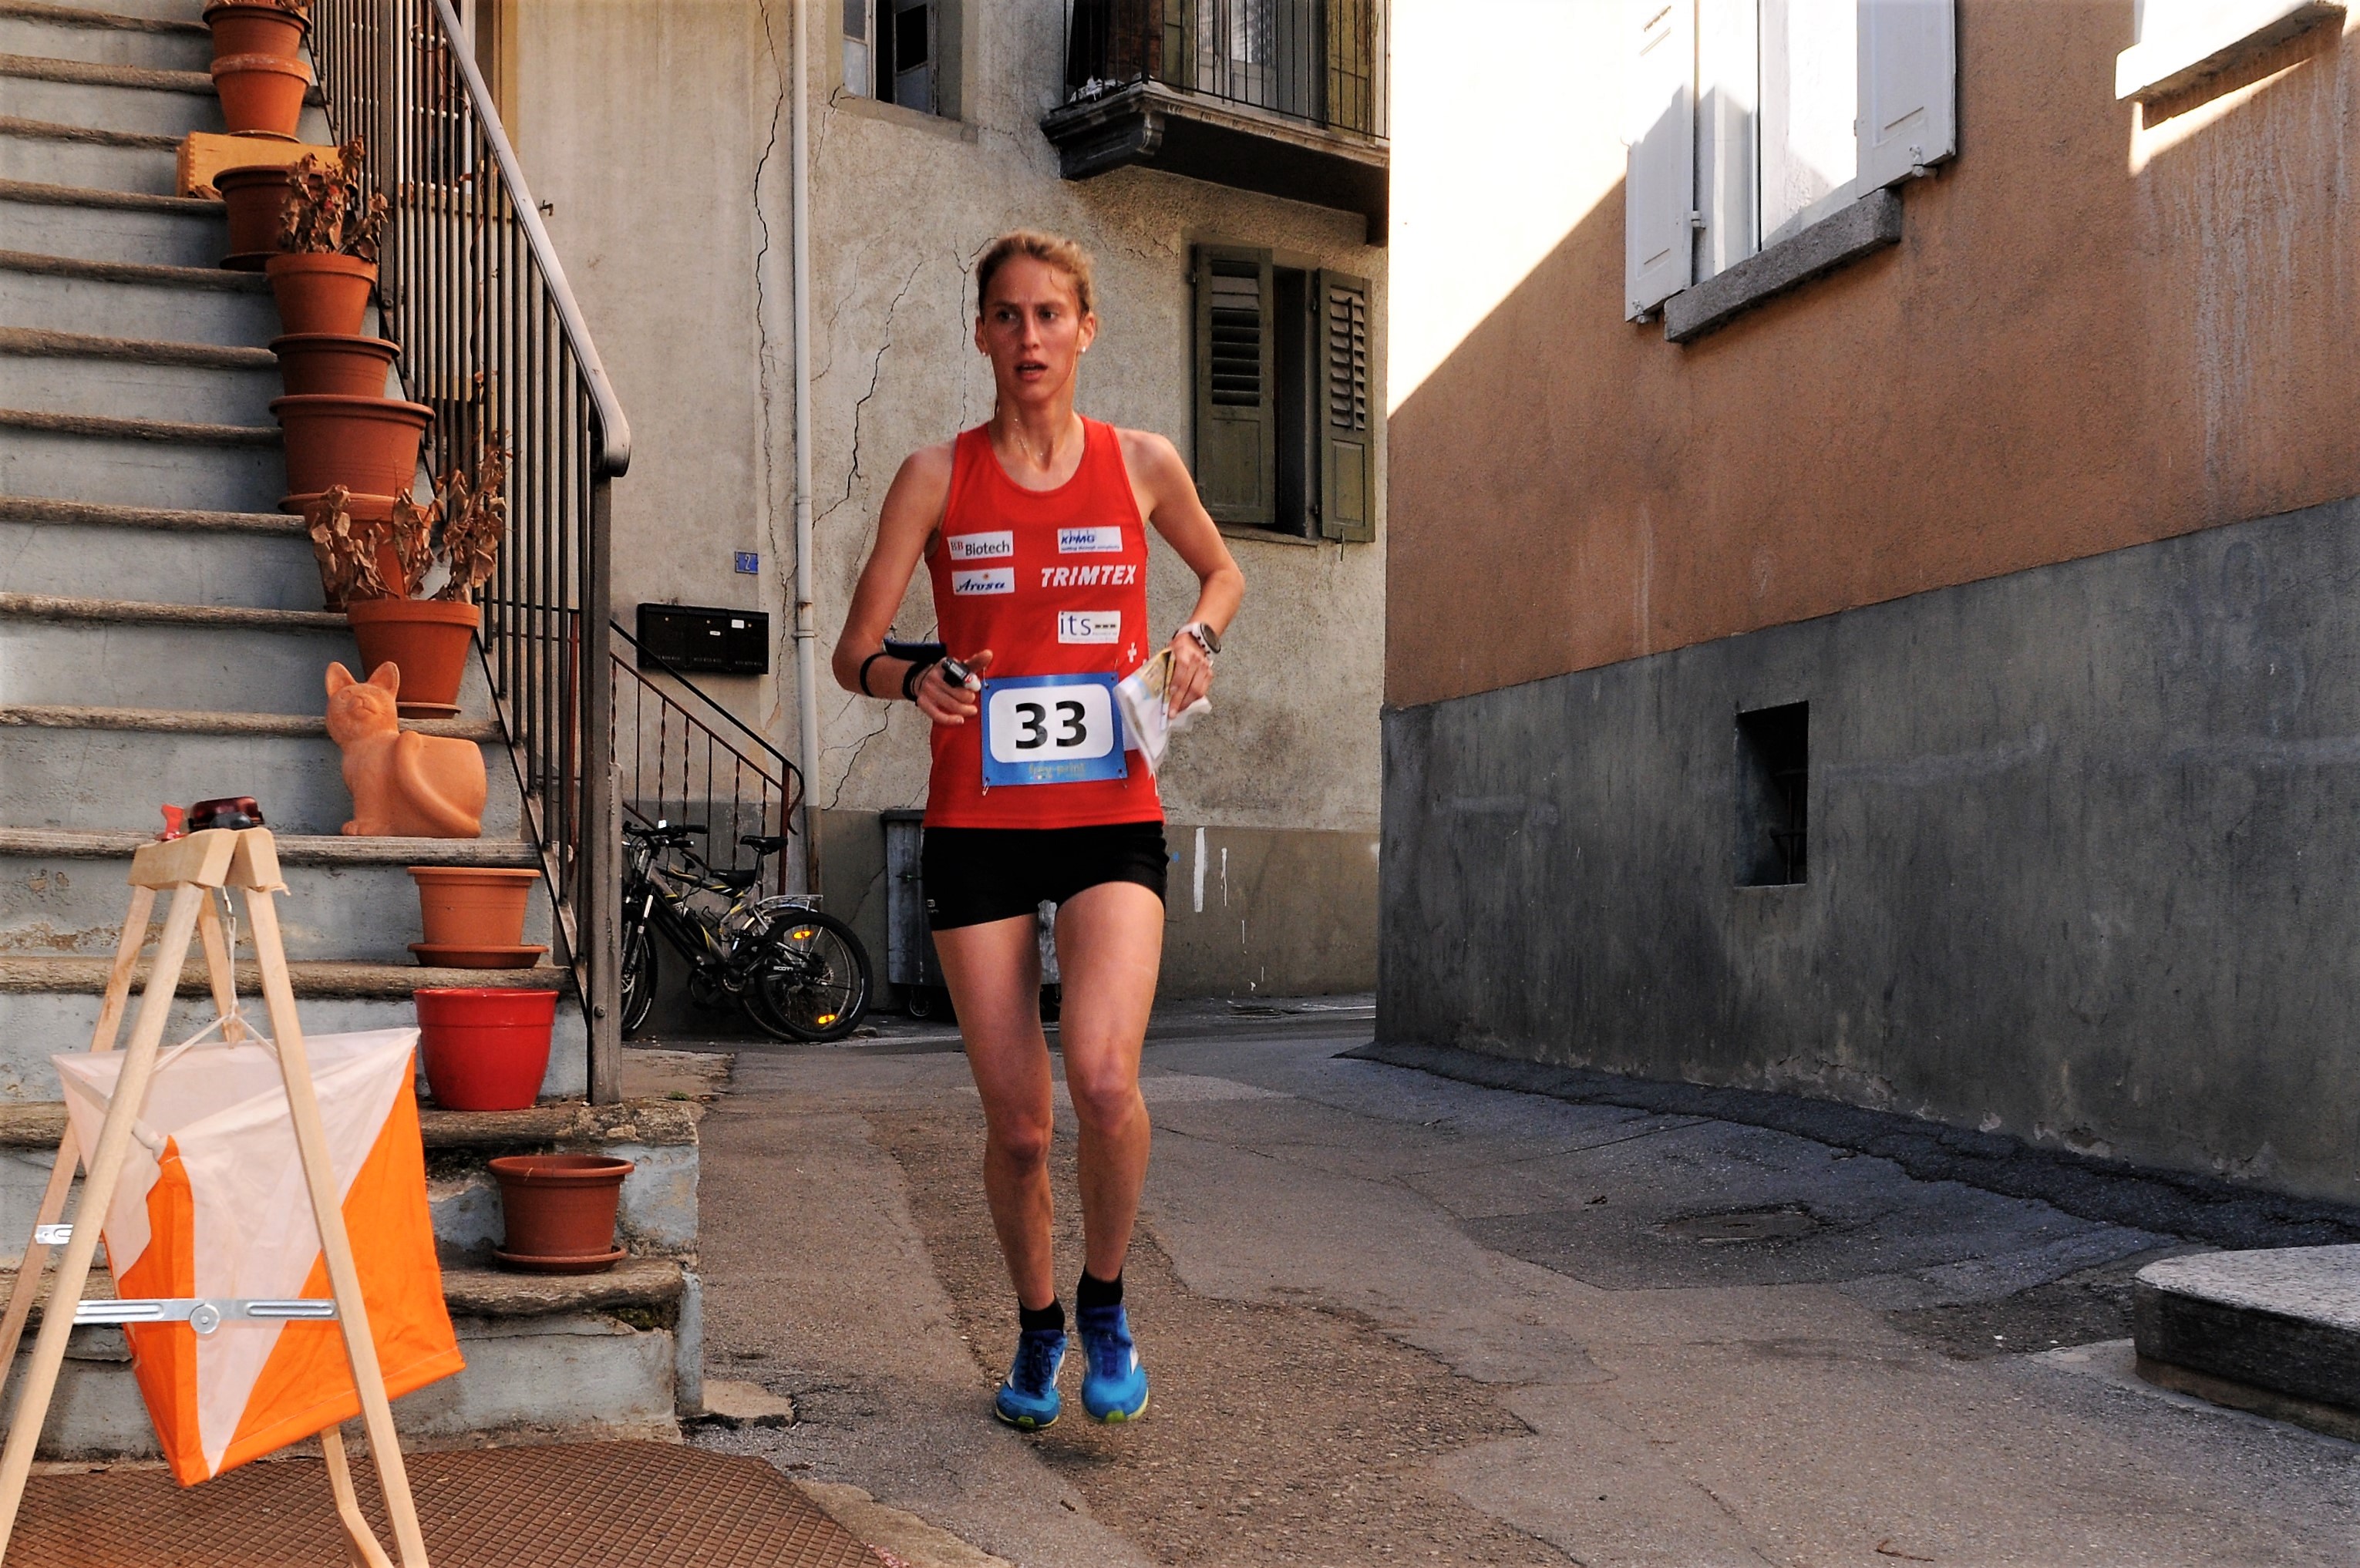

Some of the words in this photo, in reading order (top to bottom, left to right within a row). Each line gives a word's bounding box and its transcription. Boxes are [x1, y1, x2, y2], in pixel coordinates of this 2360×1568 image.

[1061, 535, 1095, 544] KPMG
[965, 540, 1010, 556] Biotech
[745, 554, 750, 570] 2
[1041, 564, 1137, 587] TRIMTEX
[956, 579, 1005, 593] Arosa
[1015, 700, 1087, 749] 33
